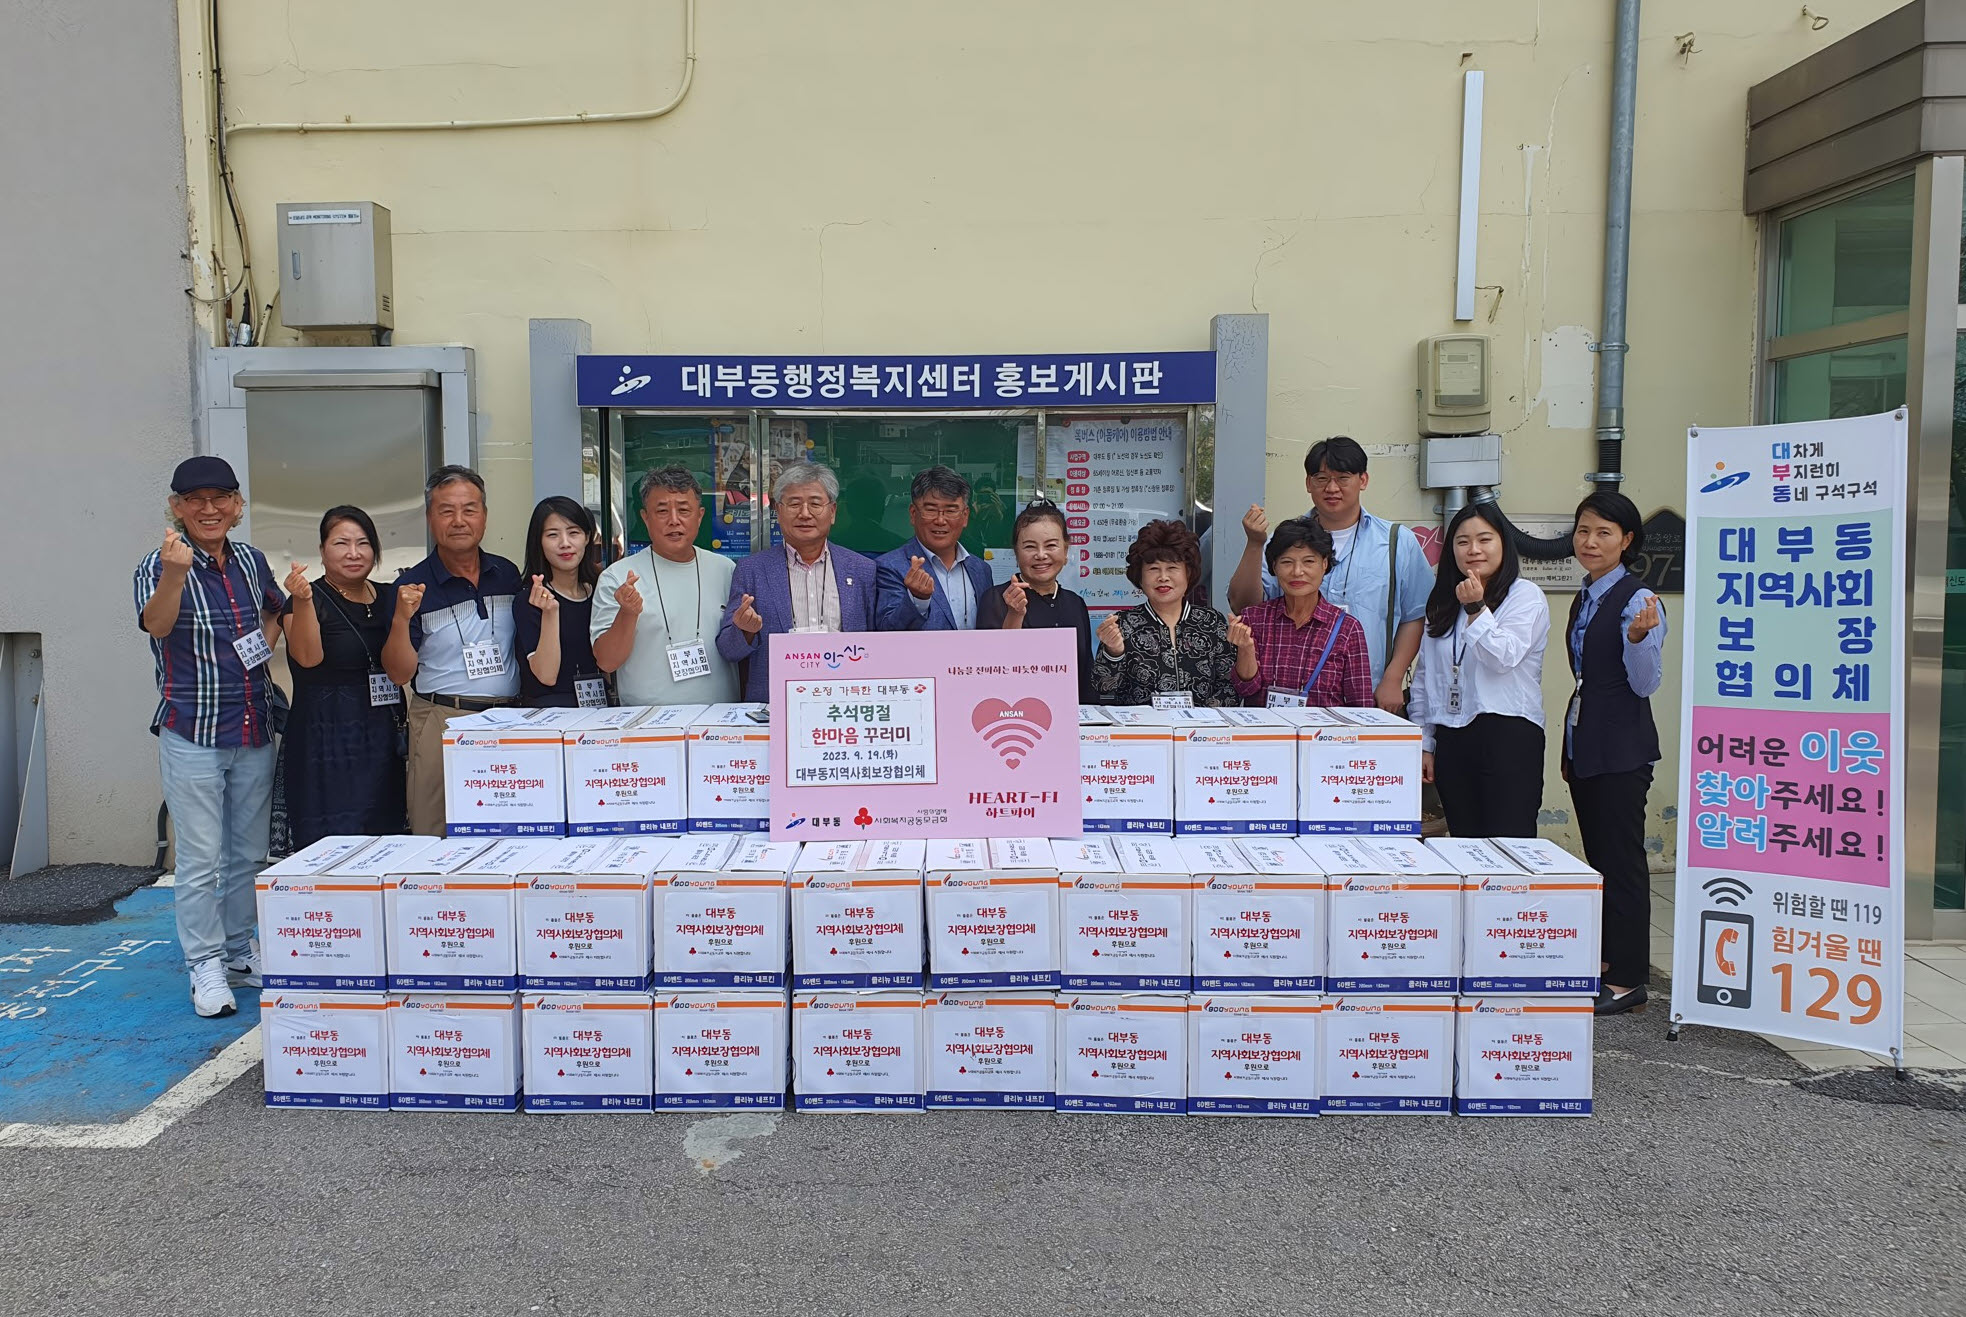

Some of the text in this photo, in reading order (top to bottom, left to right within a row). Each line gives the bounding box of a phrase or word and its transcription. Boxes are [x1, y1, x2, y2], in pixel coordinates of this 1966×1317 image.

[680, 360, 1163, 400] 대부동행정복지센터 홍보게시판
[1159, 426, 1172, 441] 안내
[1772, 442, 1824, 460] 대차게
[1772, 461, 1840, 481] 부지런히
[1773, 480, 1878, 503] 동네 구석구석
[1716, 569, 1873, 608] 지역사회
[469, 664, 504, 677] 보장협의체
[674, 665, 710, 678] 보장협의체
[948, 666, 973, 675] 나눔을
[1041, 664, 1067, 673] 에너지
[839, 685, 871, 696] 가득한
[878, 684, 910, 695] 대부동
[826, 704, 891, 723] 추석명절
[999, 710, 1024, 718] ANSAN
[812, 726, 911, 746] 한마음 꾸러미
[822, 750, 850, 761] 2023.
[1698, 729, 1885, 775] 어려운 이웃
[490, 764, 517, 775] 대부동
[611, 762, 639, 773] 대부동
[1223, 760, 1251, 771] 대부동
[1349, 759, 1377, 771] 대부동
[796, 764, 925, 781] 대부동지역사회보장협의체
[463, 778, 544, 790] 지역사회보장협의체
[585, 776, 666, 788] 지역사회보장협의체
[1195, 775, 1278, 786] 지역사회보장협의체
[1321, 775, 1404, 786] 지역사회보장협의체
[968, 791, 1059, 804] HEART-FI
[985, 807, 1035, 819] 하트파이
[875, 816, 948, 826] 사회복지공동모금회
[705, 907, 736, 919] 대부동
[845, 907, 875, 918] 대부동
[977, 907, 1007, 919] 대부동
[1772, 891, 1882, 925] 위험할 땐 119
[304, 911, 333, 922] 대부동
[437, 910, 467, 922] 대부동
[565, 912, 594, 924] 대부동
[1108, 910, 1139, 921] 대부동
[1240, 911, 1271, 923] 대부동
[1378, 912, 1410, 924] 대부동
[1517, 911, 1549, 923] 대부동
[277, 927, 362, 939] 지역사회보장협의체
[409, 927, 495, 939] 지역사회보장협의체
[536, 929, 623, 941] 지역사회보장협의체
[676, 924, 764, 936] 지역사회보장협의체
[816, 924, 904, 936] 지역사회보장협의체
[947, 924, 1036, 936] 지역사회보장협의체
[1078, 926, 1168, 939] 지역사회보장협의체
[1210, 928, 1301, 940] 지역사회보장협의체
[1348, 929, 1438, 941] 지역사회보장협의체
[1486, 928, 1577, 940] 지역사회보장협의체
[1771, 926, 1882, 967] 힘겨울 땐
[1771, 962, 1883, 1025] 129
[310, 1030, 339, 1042] 대부동
[435, 1030, 463, 1041] 대부동
[573, 1030, 603, 1042] 대부동
[701, 1029, 732, 1041] 대부동
[842, 1029, 873, 1040] 대부동
[975, 1026, 1005, 1038] 대부동
[1108, 1032, 1139, 1044] 대부동
[1369, 1032, 1400, 1044] 대부동
[1241, 1033, 1272, 1045] 대부동
[1512, 1033, 1543, 1045] 대부동
[282, 1046, 367, 1058] 지역사회보장협의체
[406, 1046, 491, 1058] 지역사회보장협의체
[543, 1046, 631, 1058] 지역사회보장협의체
[672, 1045, 760, 1057] 지역사회보장협의체
[813, 1045, 901, 1057] 지역사회보장협의체
[945, 1044, 1034, 1056] 지역사회보장협의체
[1078, 1048, 1167, 1061] 지역사회보장협의체
[1211, 1049, 1301, 1062] 지역사회보장협의체
[1339, 1049, 1429, 1061] 지역사회보장협의체
[1481, 1051, 1572, 1063] 지역사회보장협의체
